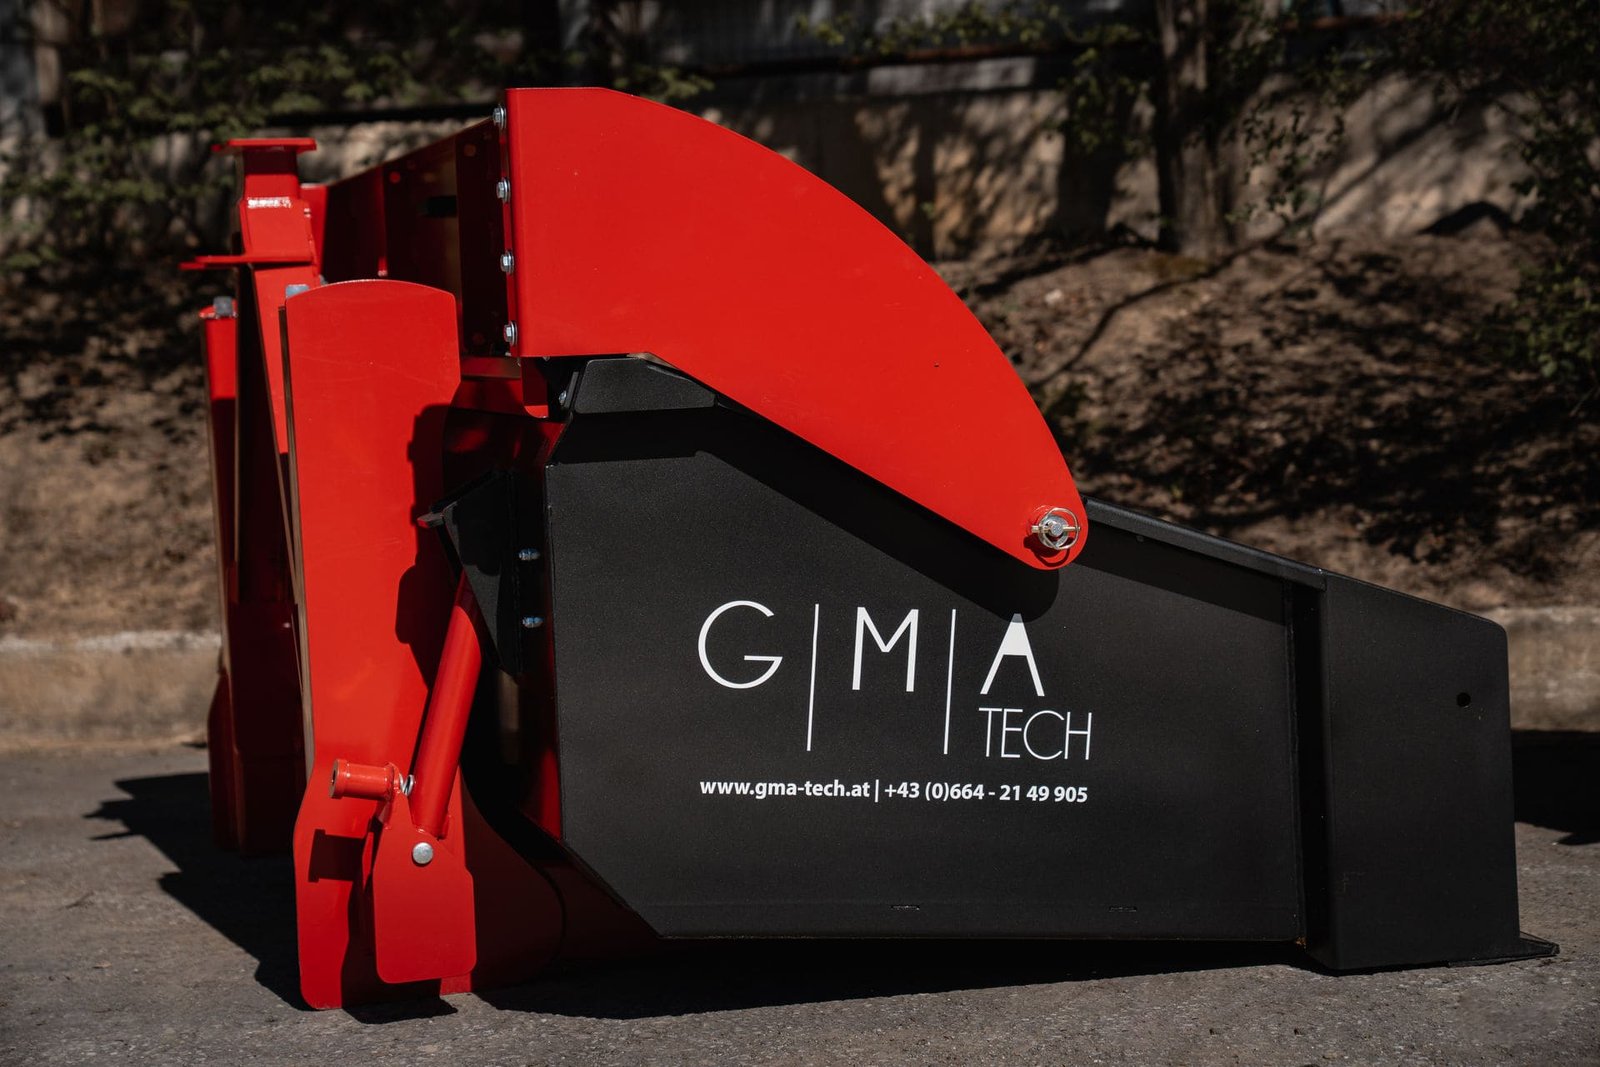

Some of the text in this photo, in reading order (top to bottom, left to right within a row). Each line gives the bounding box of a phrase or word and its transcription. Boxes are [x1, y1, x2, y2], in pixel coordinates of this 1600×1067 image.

[978, 706, 1093, 761] TECH
[699, 778, 871, 800] www.gma-tech.at
[884, 781, 920, 799] +43
[924, 781, 985, 802] (0)664
[998, 784, 1021, 801] 21
[1025, 785, 1050, 802] 49
[1053, 785, 1088, 803] 905
